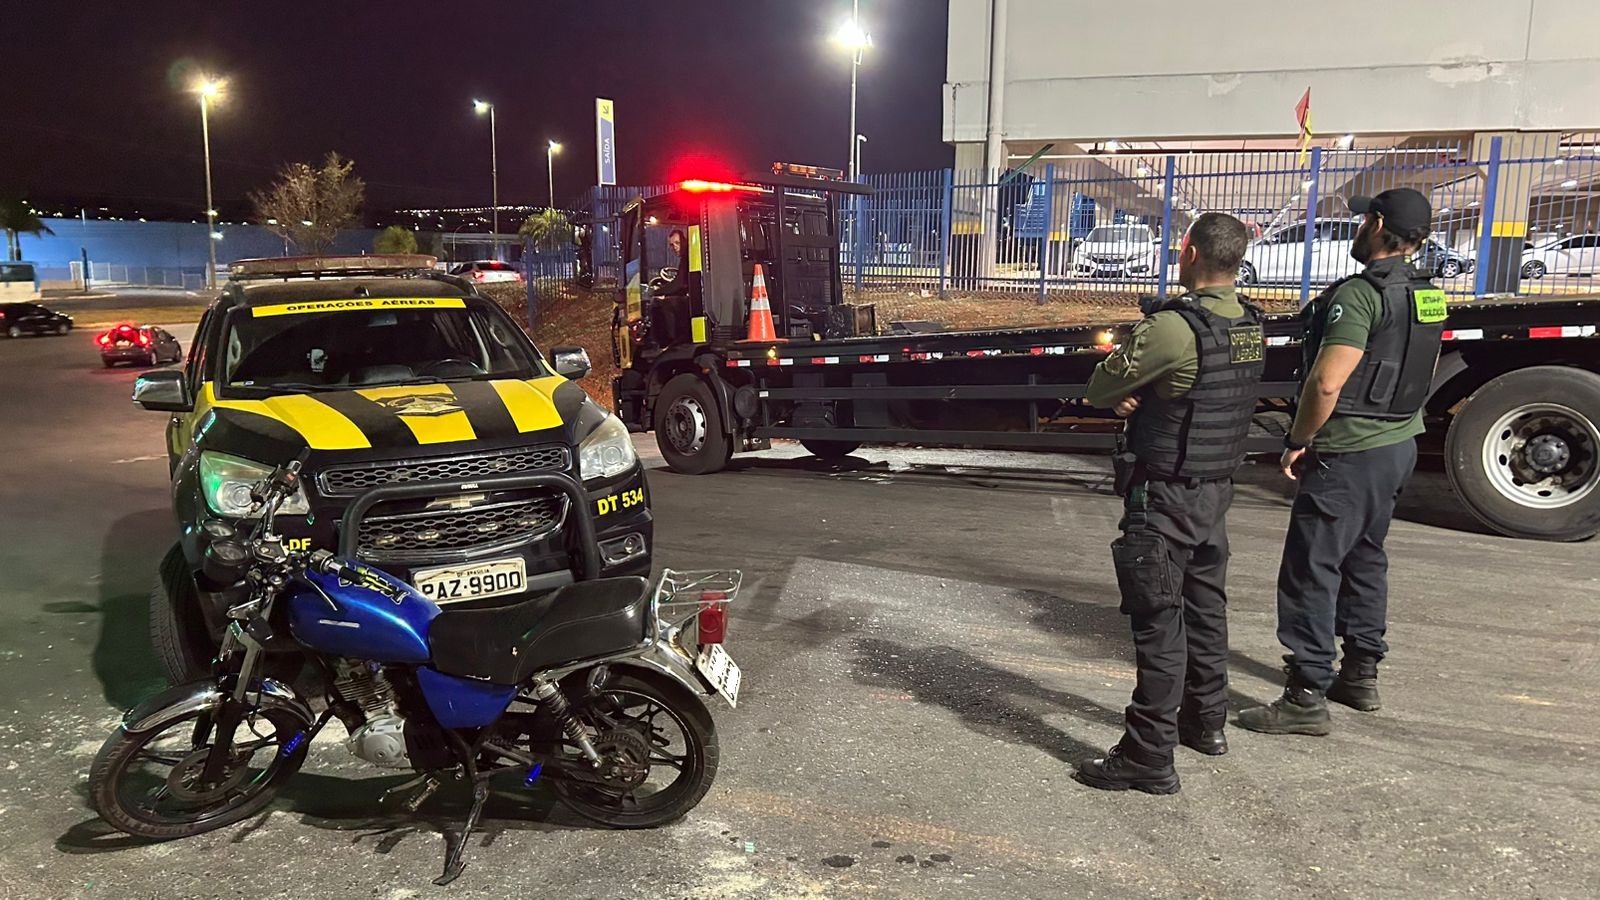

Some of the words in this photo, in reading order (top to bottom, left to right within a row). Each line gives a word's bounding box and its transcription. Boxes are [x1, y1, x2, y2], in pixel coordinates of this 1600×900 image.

[286, 300, 373, 311] OPERAÇÕES
[597, 494, 618, 515] DT
[622, 487, 644, 508] 534
